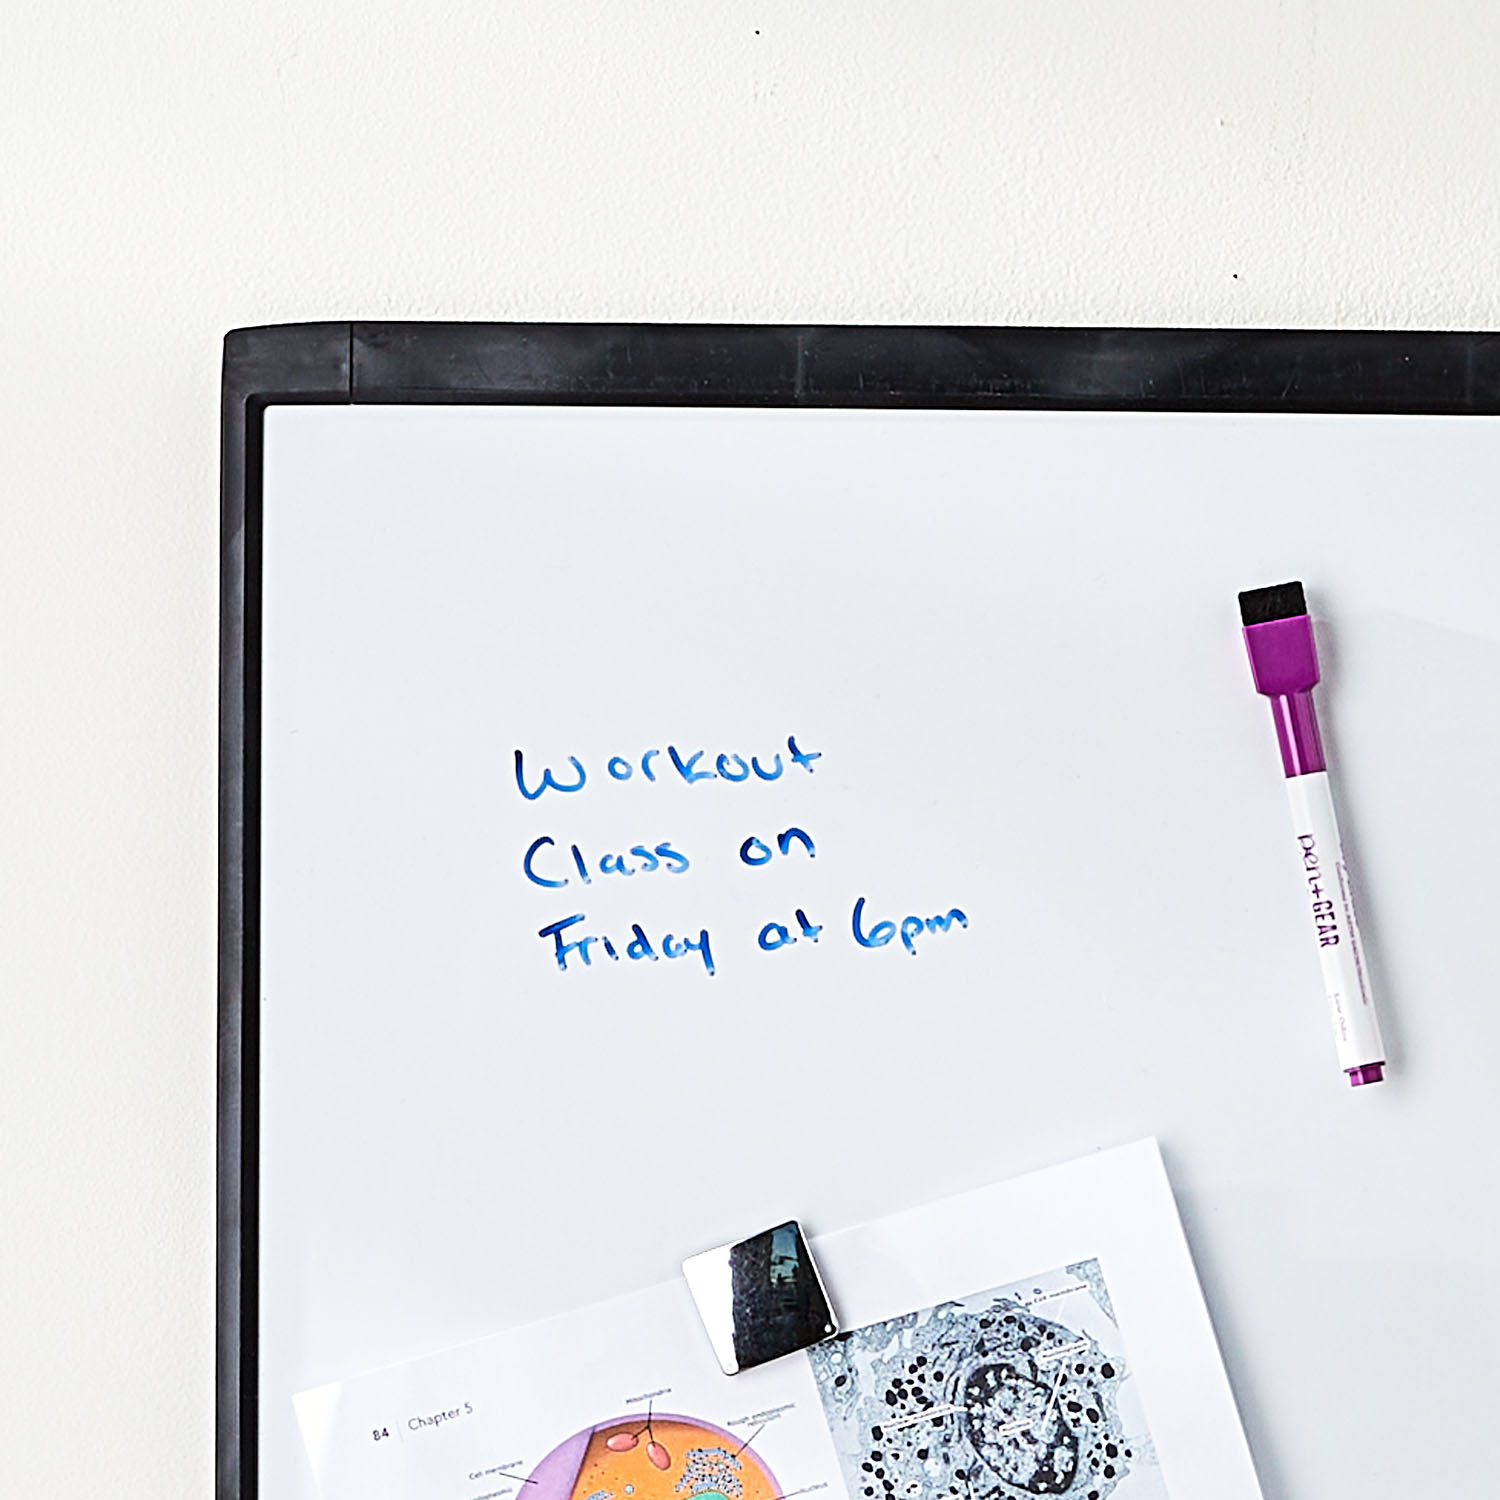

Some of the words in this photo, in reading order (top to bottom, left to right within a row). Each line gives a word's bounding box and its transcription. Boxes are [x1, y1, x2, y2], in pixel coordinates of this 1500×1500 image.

[514, 736, 822, 800] Workout
[523, 836, 690, 888] Class
[739, 827, 815, 867] on
[538, 914, 716, 976] Friday
[758, 909, 823, 951] at
[852, 897, 968, 956] 6pm
[373, 1427, 389, 1441] 84
[408, 1408, 460, 1430] Chapter
[464, 1402, 473, 1415] 5
